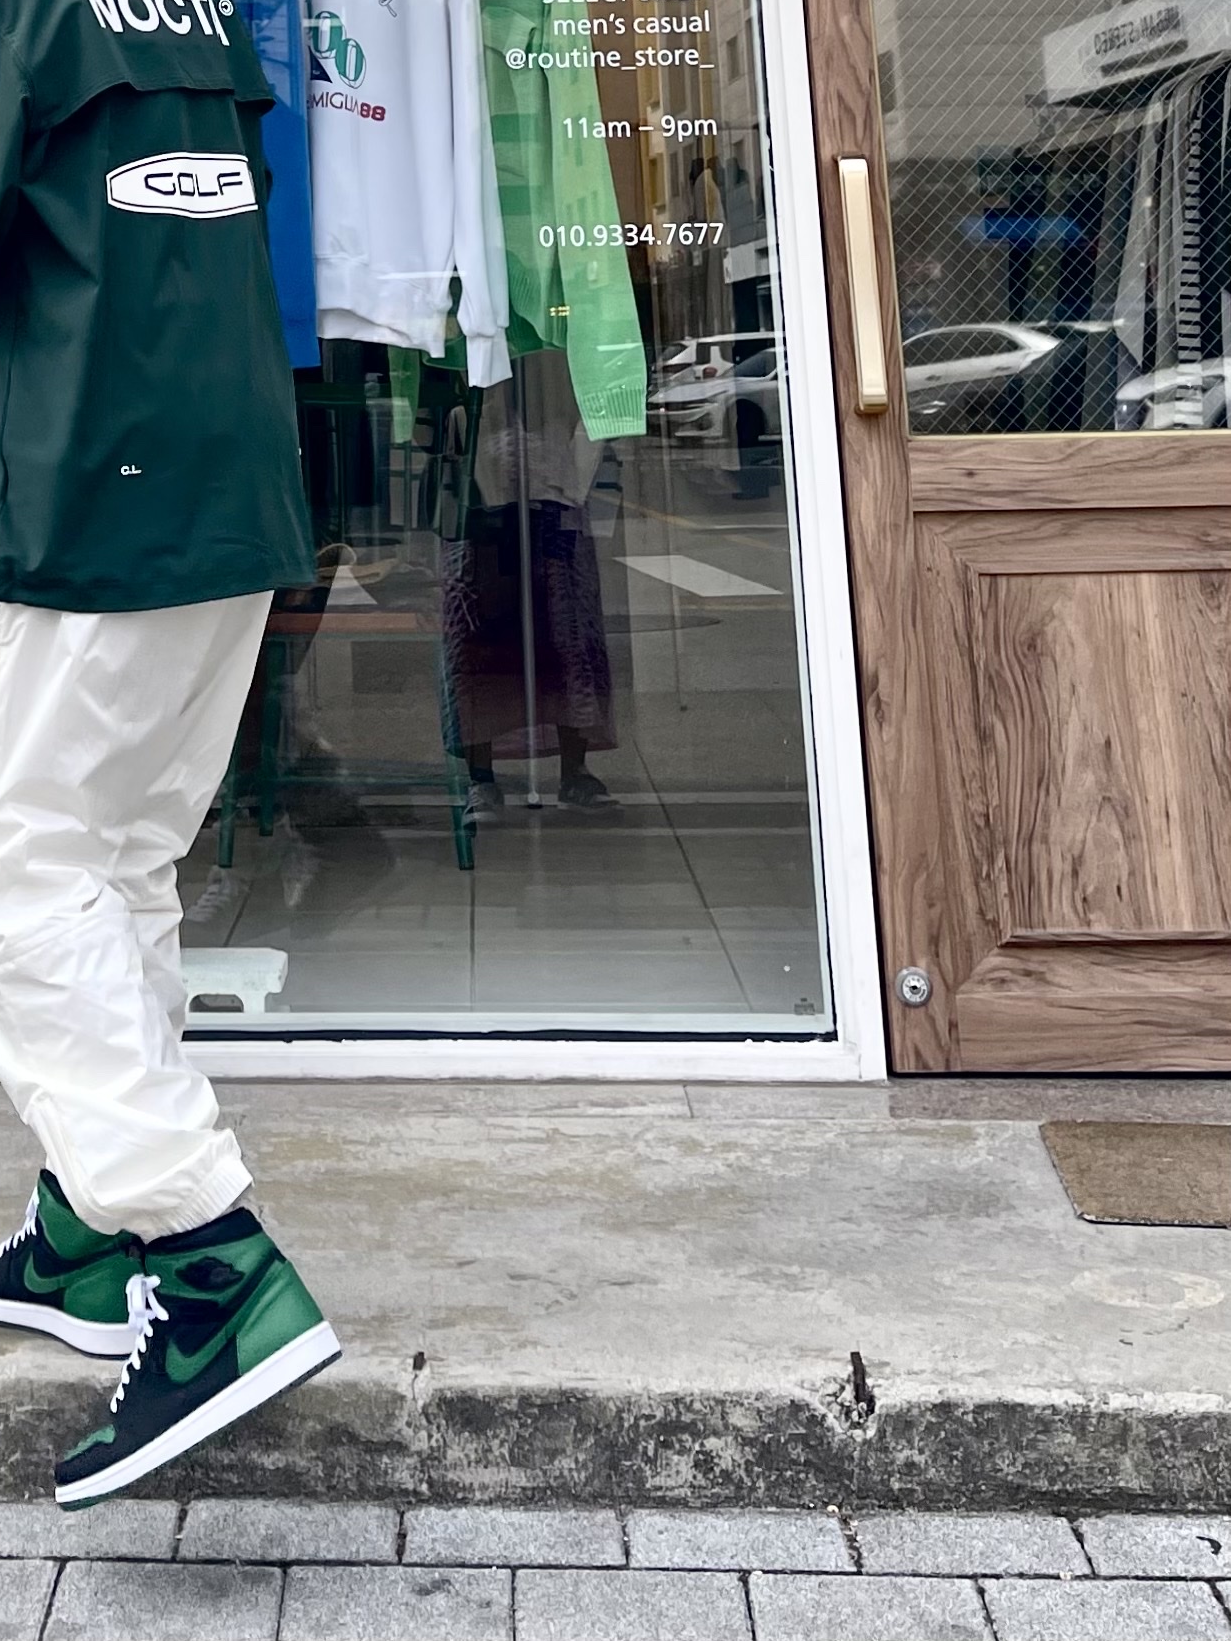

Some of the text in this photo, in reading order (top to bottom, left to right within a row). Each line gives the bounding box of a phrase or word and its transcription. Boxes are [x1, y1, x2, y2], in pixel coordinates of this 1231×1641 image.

[633, 10, 710, 33] casual
[506, 46, 715, 71] @routine_store_
[563, 118, 631, 138] 11am
[661, 115, 717, 142] 9pm
[144, 171, 243, 197] GOLF
[540, 222, 724, 247] 010.9334.7677
